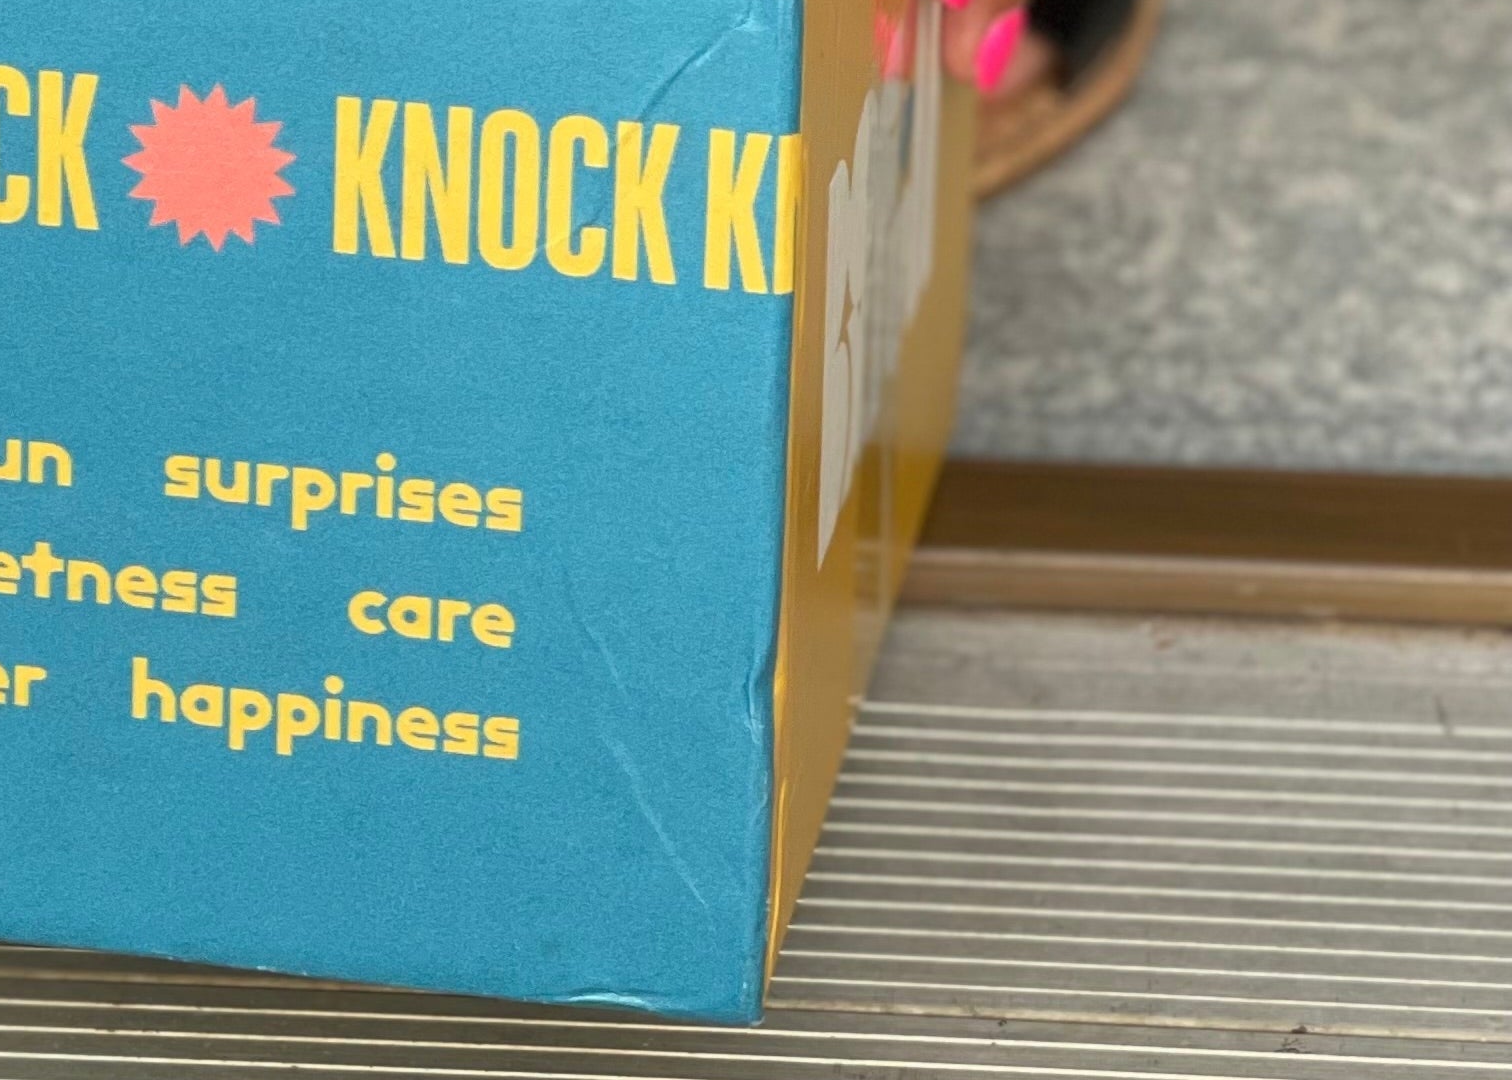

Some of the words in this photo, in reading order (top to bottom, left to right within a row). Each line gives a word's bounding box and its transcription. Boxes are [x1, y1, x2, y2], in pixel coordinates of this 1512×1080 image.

[332, 96, 680, 285] KNOCK
[164, 452, 523, 532] surprises
[347, 590, 516, 648] care
[131, 656, 520, 760] happiness
